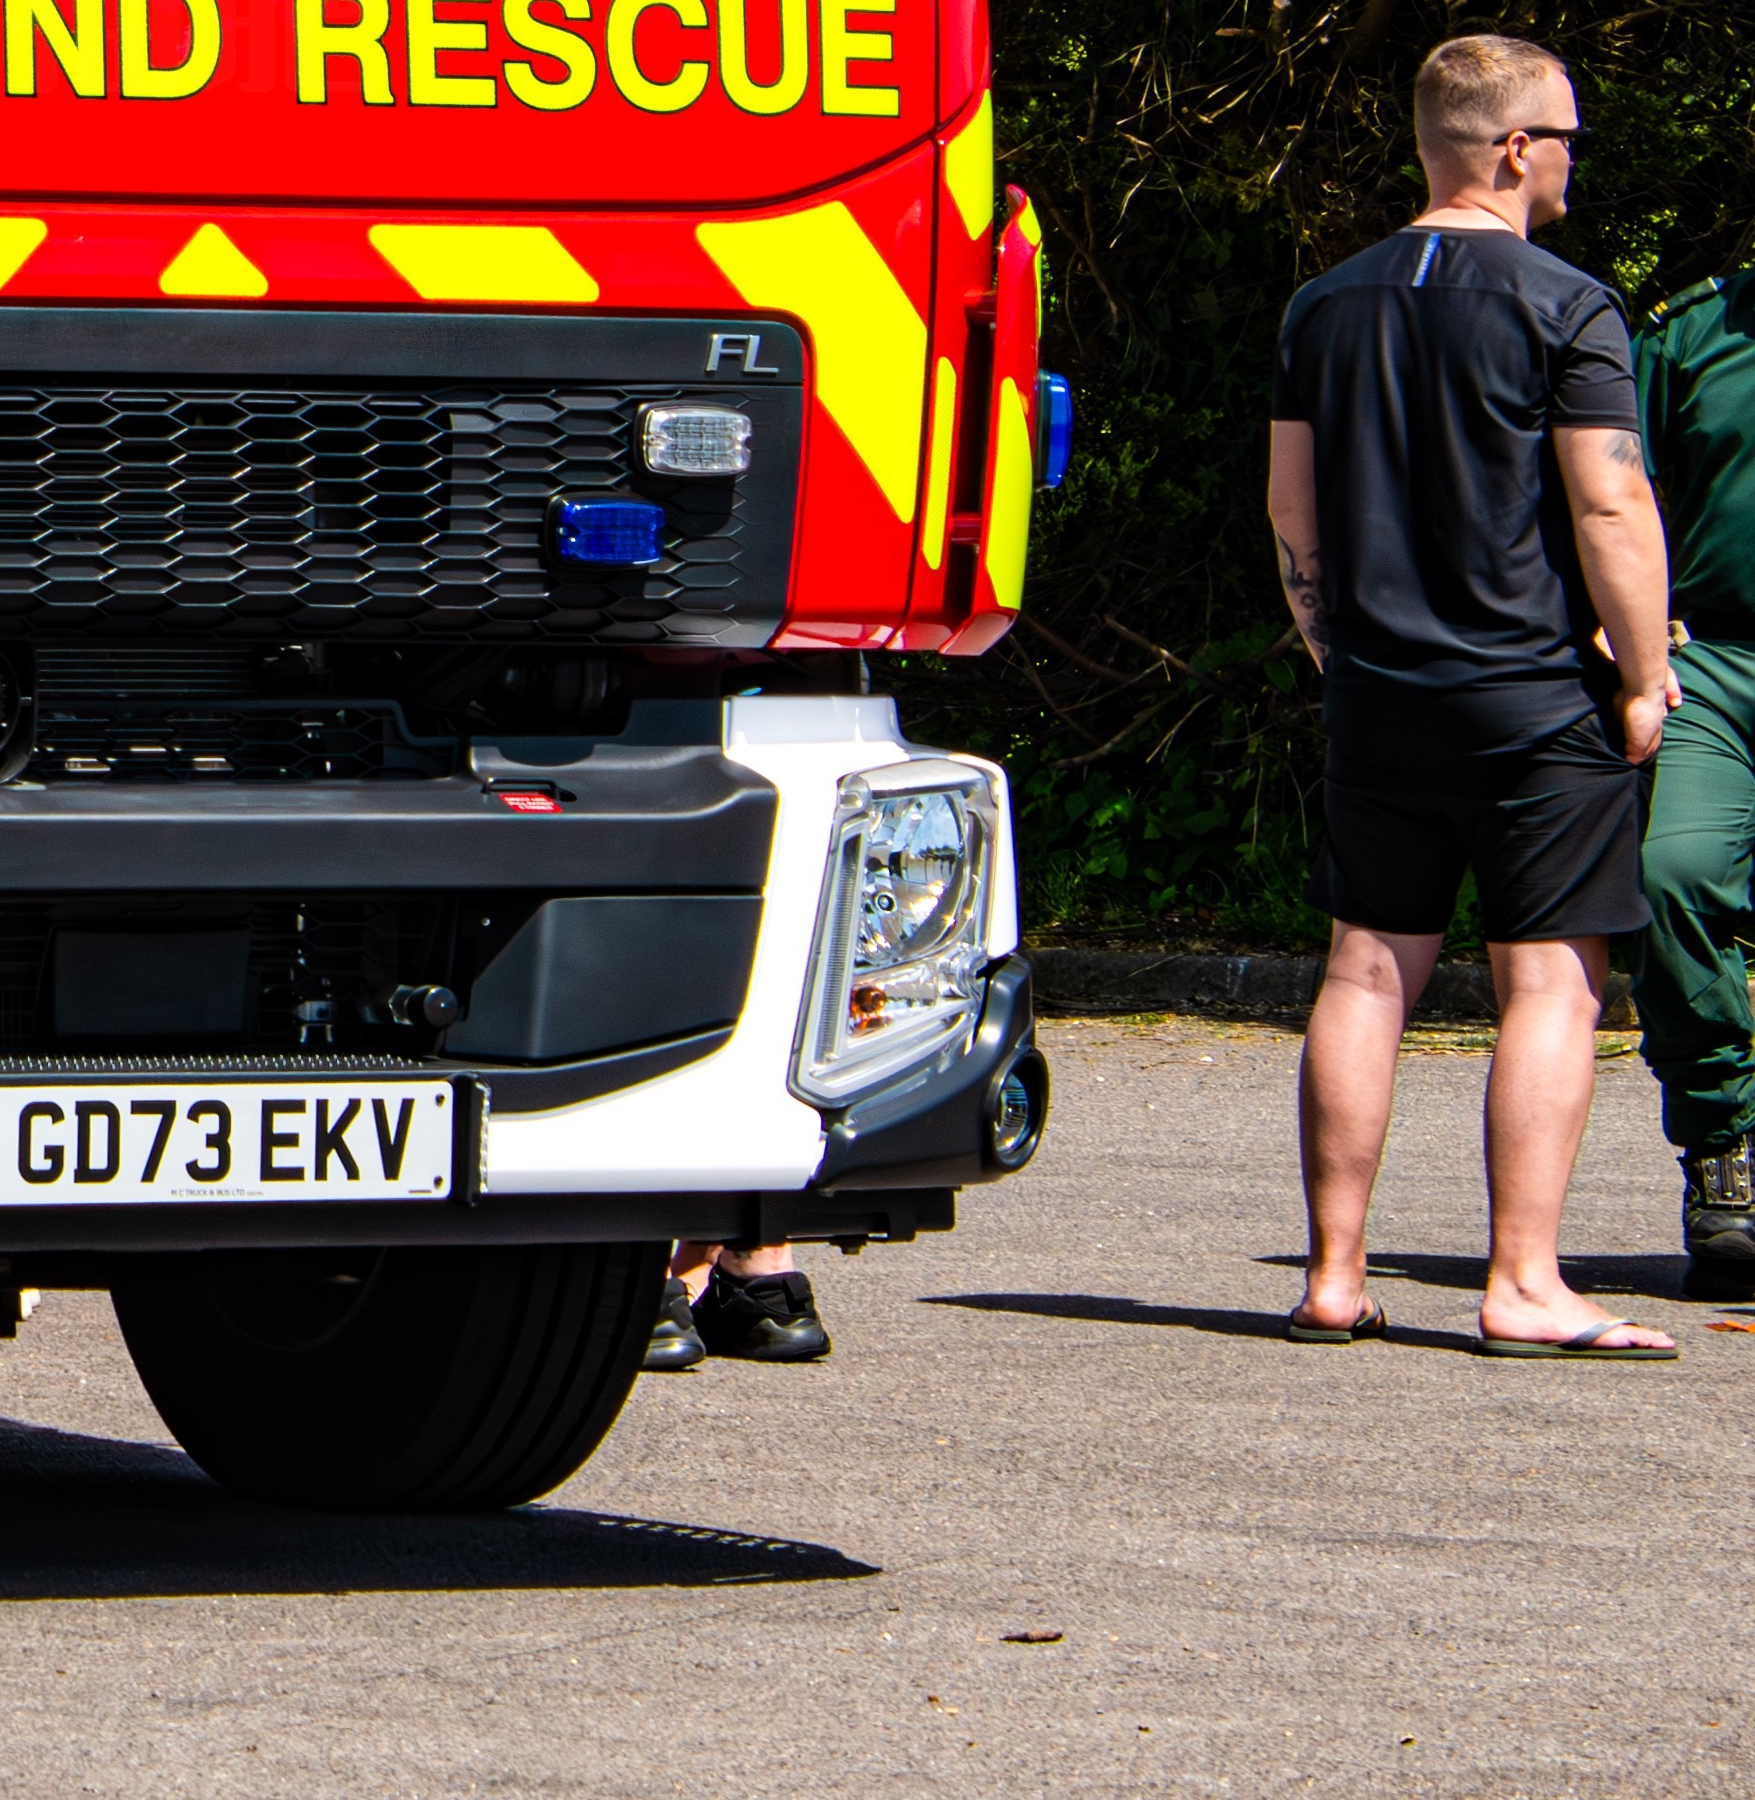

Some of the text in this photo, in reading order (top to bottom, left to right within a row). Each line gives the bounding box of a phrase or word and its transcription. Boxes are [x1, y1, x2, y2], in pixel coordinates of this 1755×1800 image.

[705, 333, 780, 374] FL
[17, 1097, 415, 1185] GD73 EKV
[185, 1188, 207, 1197] TRUCK
